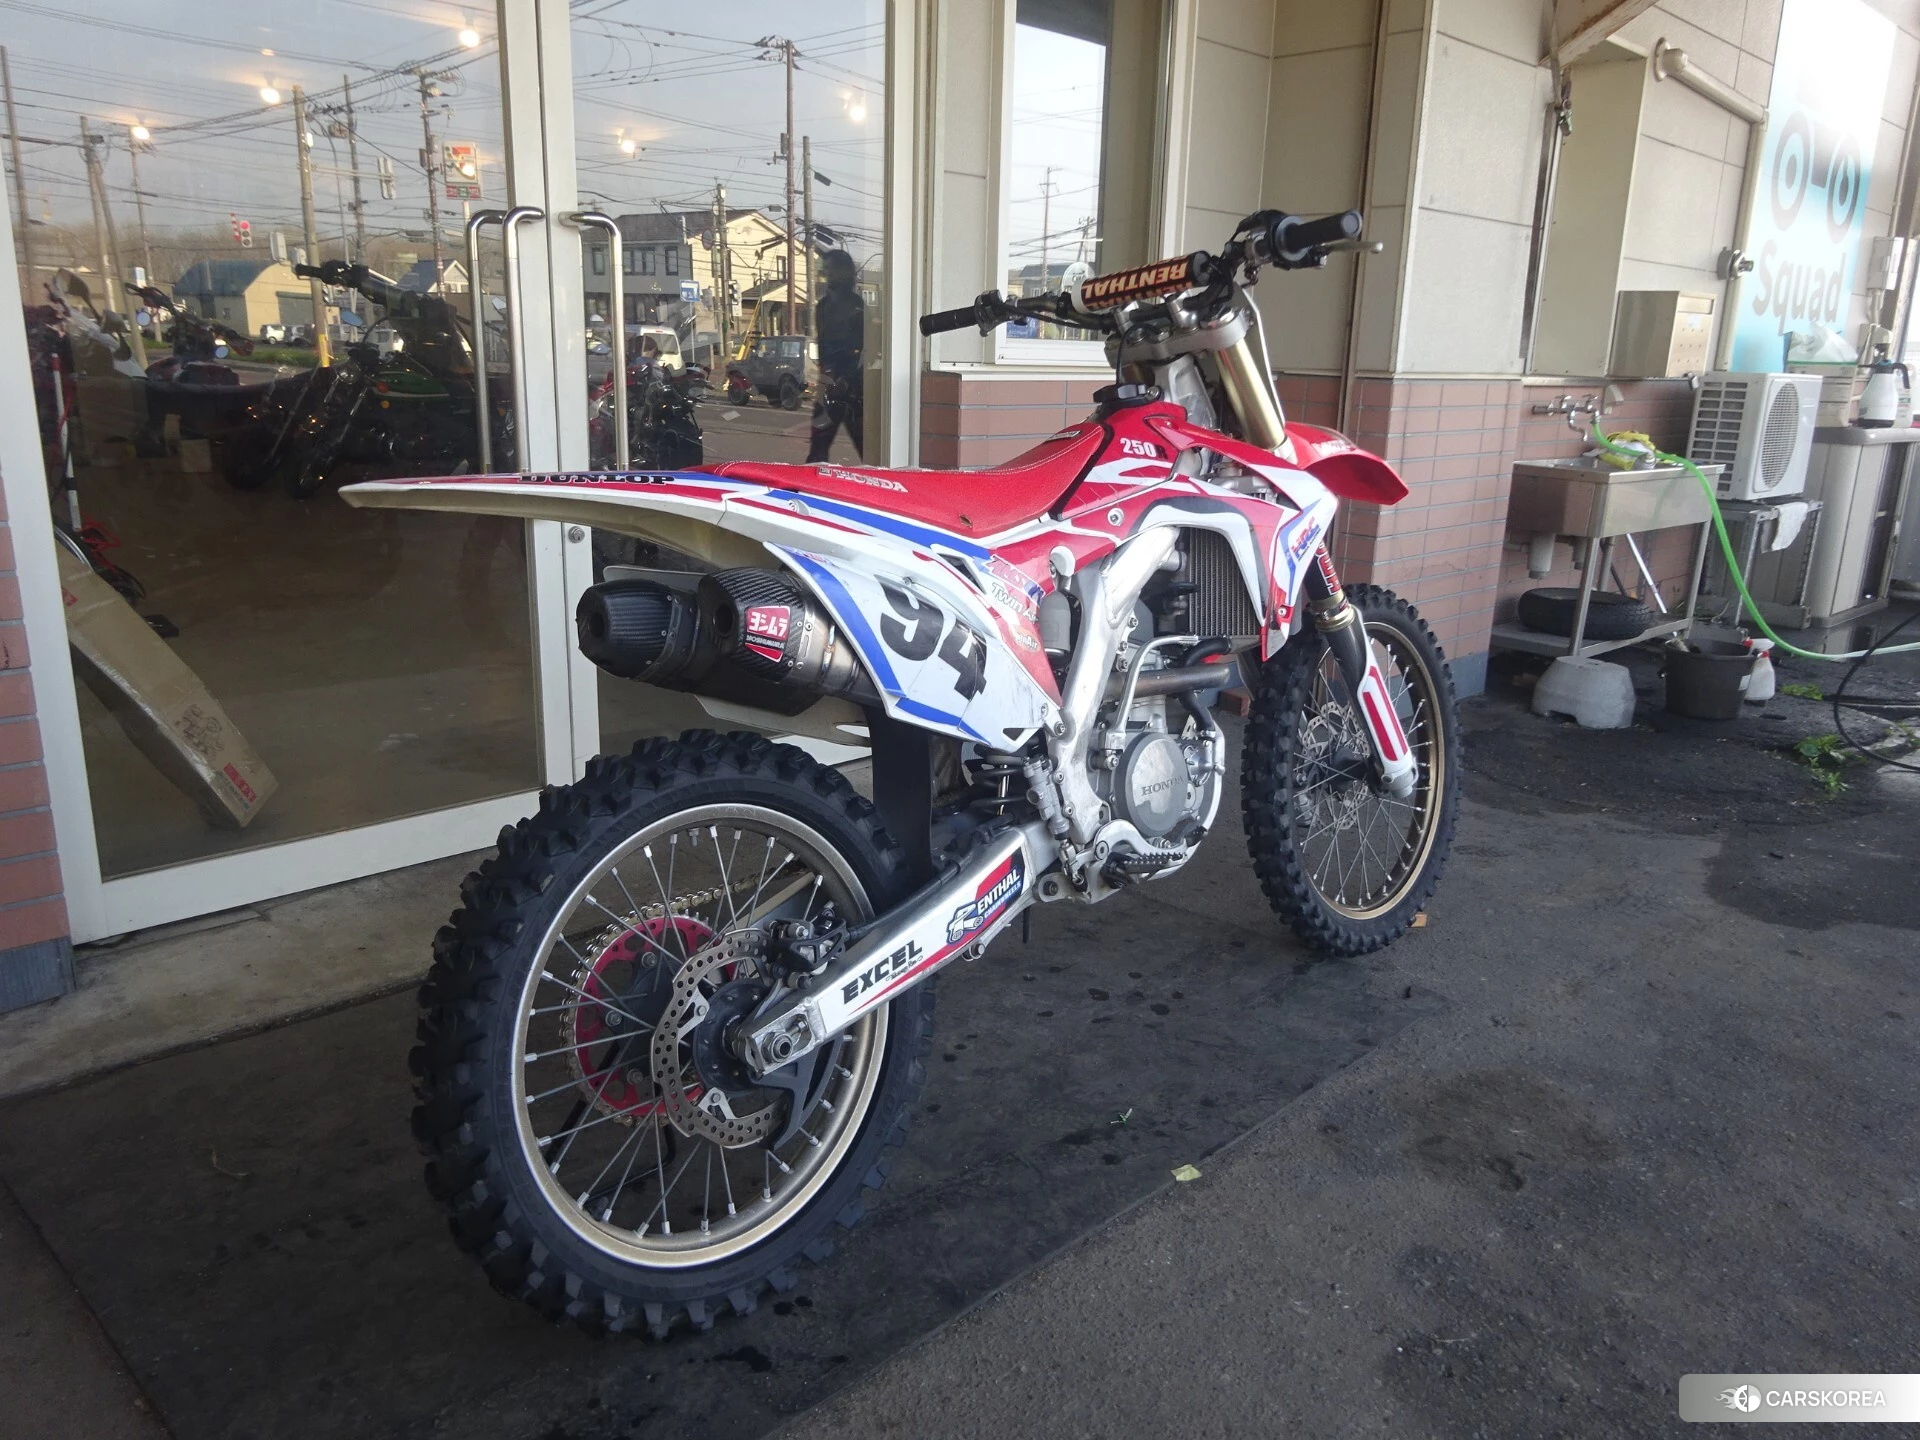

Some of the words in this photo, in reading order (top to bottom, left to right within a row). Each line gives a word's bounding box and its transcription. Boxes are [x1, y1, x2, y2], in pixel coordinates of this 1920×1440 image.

[1081, 261, 1189, 300] RENTHAL
[1752, 240, 1847, 336] Squad
[518, 474, 675, 485] DUNLOP
[991, 581, 1023, 615] Twin
[749, 611, 787, 637] ヨシムラ
[874, 574, 987, 702] 94
[1141, 776, 1184, 796] HONDA
[840, 940, 923, 1005] EXCEL
